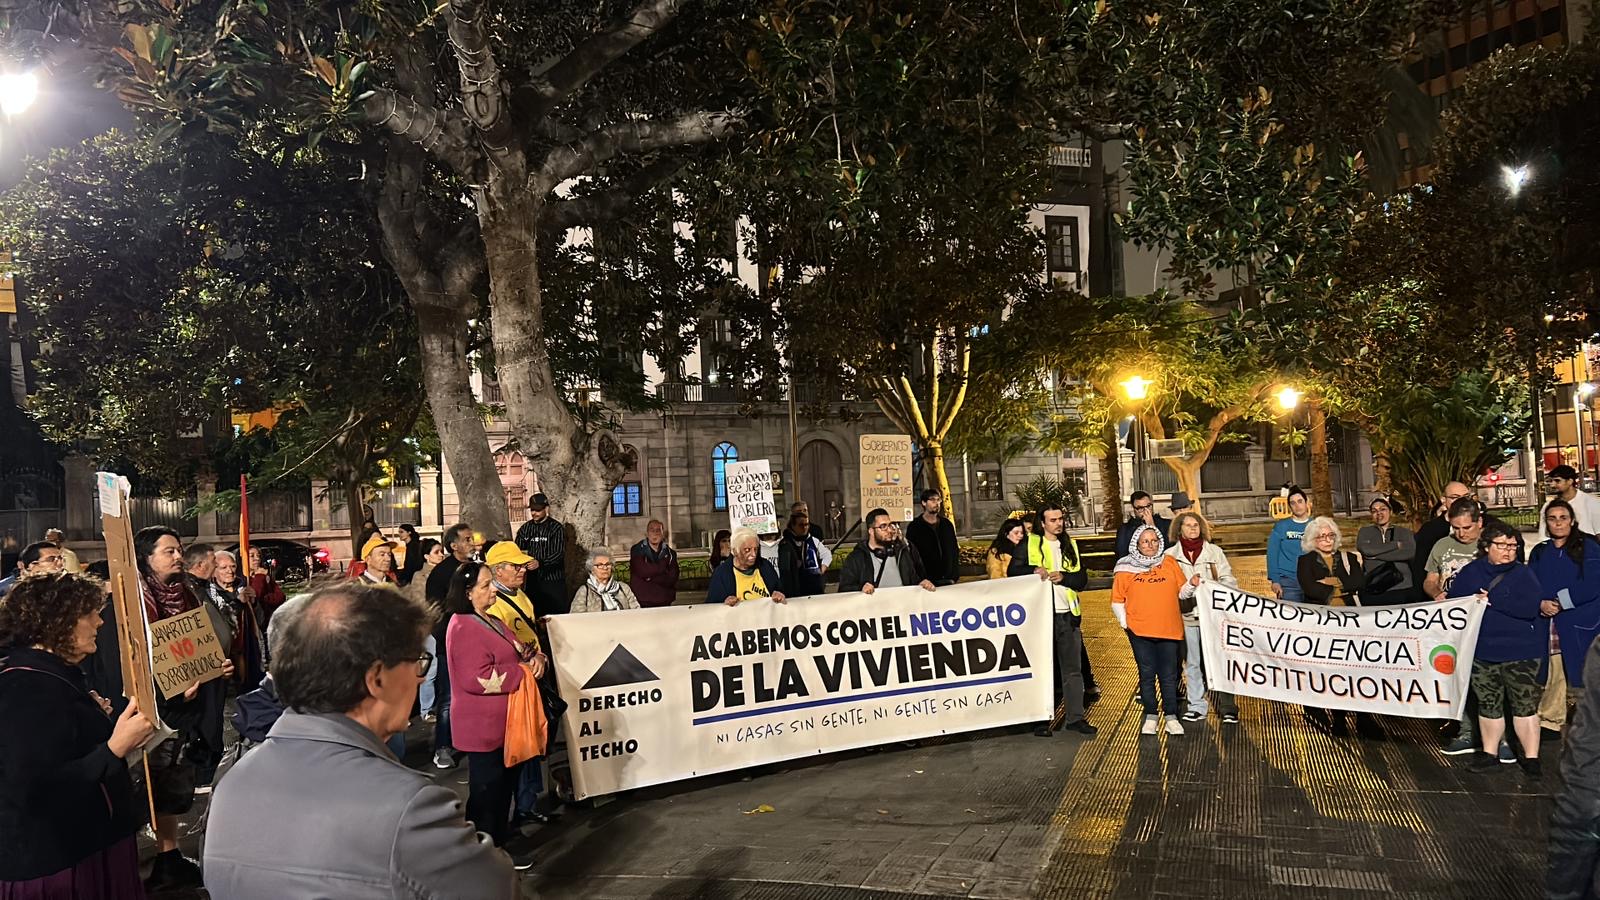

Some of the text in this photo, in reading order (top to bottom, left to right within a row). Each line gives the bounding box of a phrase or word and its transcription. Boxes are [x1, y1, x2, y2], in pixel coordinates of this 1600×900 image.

[861, 436, 909, 452] GOBIERNOS
[861, 454, 907, 466] COMPLICES
[1211, 589, 1468, 631] EXPROPIAR CASAS
[690, 603, 1027, 662] ACABEMOS CON EL NEGOCIO
[1226, 624, 1416, 666] ES VIOLENCIA
[169, 637, 196, 662] NO
[690, 633, 1031, 713] DE LA VIVIENDA
[1226, 659, 1451, 705] INSTITUCIONAL
[578, 688, 662, 712] DERECHO
[716, 690, 1013, 743] NI CASAS SIN GENTE, NI GENTE SIN CASA
[579, 720, 602, 737] AL
[580, 739, 638, 761] TECHO
